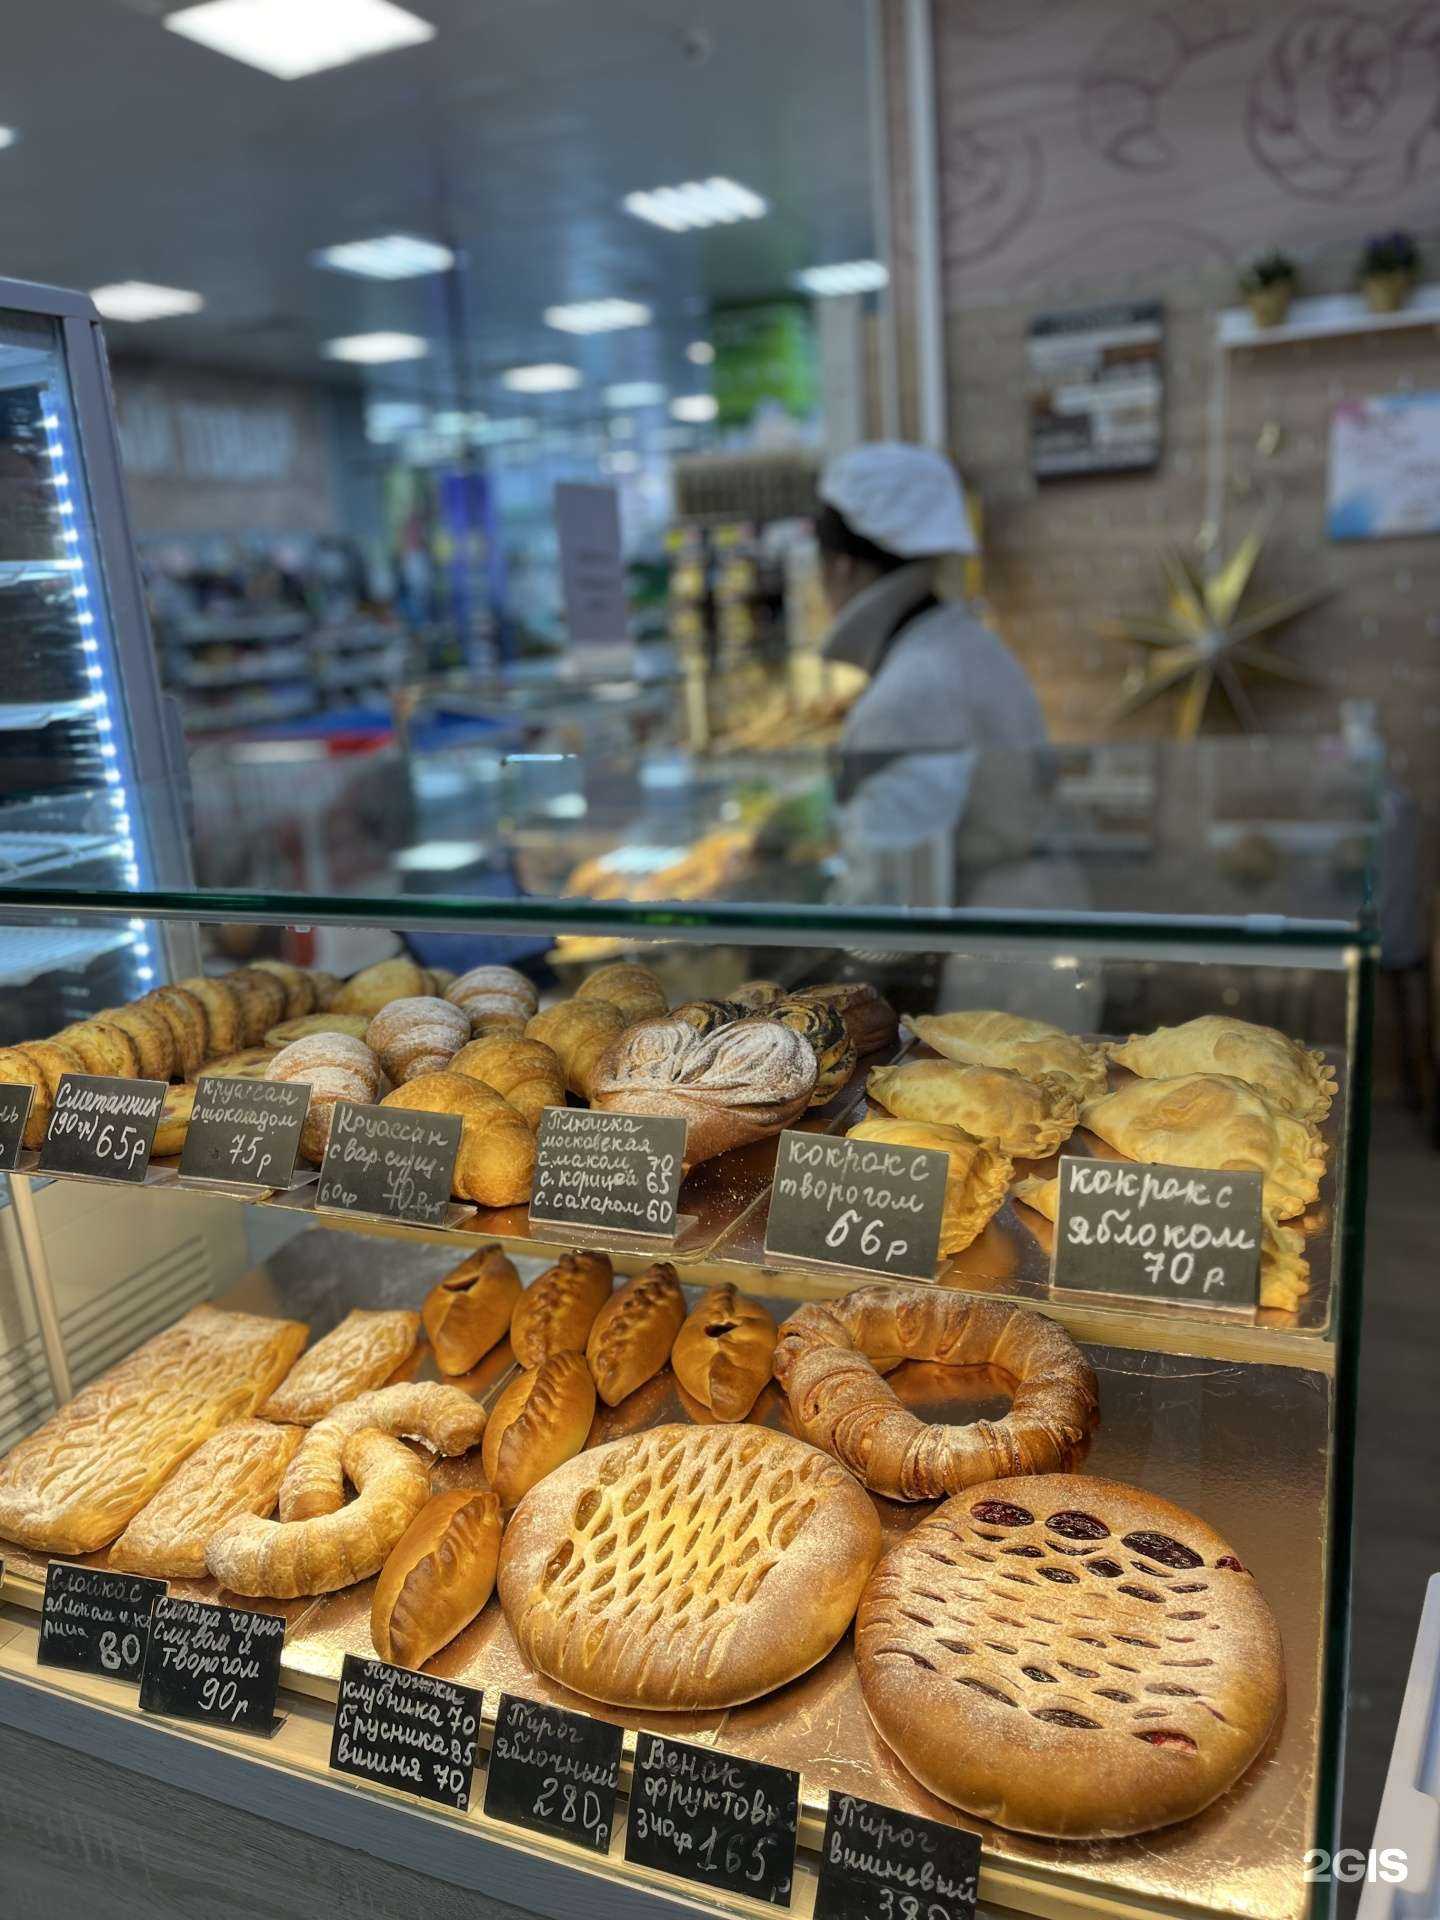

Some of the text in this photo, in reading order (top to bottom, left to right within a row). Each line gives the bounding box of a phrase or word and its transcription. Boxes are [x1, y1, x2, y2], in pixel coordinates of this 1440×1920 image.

[56, 1082, 162, 1118] Сметанник
[202, 1107, 297, 1132] шоколадом
[338, 1106, 449, 1146] Круассан
[548, 1111, 643, 1133] Плюшка
[329, 1144, 341, 1159] с
[542, 1135, 654, 1153] московская
[647, 1154, 674, 1172] 70
[559, 1170, 639, 1197] корицей
[646, 1171, 672, 1195] 65
[779, 1172, 925, 1213] творогом
[1216, 1186, 1233, 1208] с
[553, 1192, 644, 1216] сахаром
[646, 1200, 673, 1224] 60
[1068, 1209, 1255, 1250] яблоком
[99, 1631, 140, 1669] 80
[239, 1640, 252, 1655] и
[447, 1706, 476, 1735] 70
[507, 1703, 584, 1743] Пирог
[450, 1739, 477, 1766] 85
[834, 1796, 938, 1853] Пирог
